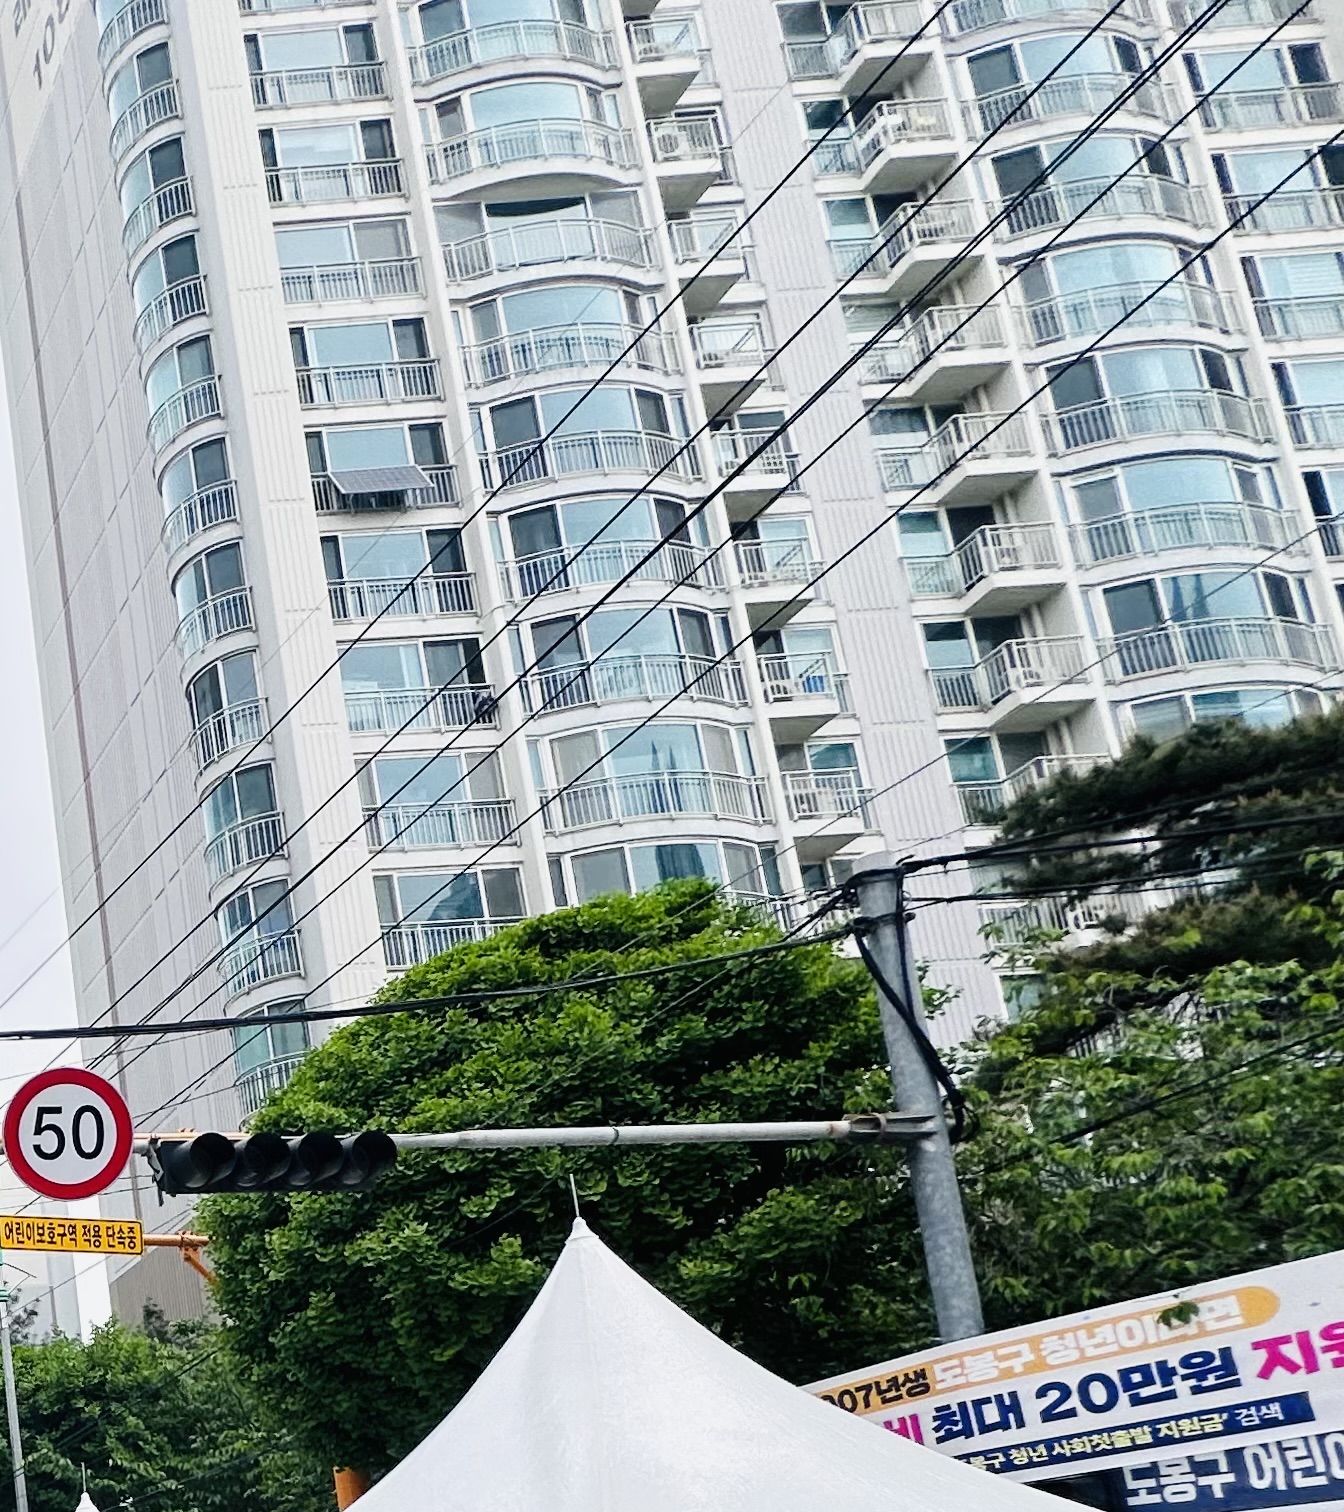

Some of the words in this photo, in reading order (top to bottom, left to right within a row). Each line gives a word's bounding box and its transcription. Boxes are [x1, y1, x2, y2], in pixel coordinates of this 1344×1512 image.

[31, 1104, 105, 1161] 50
[4, 1219, 78, 1247] 어린이보호구역
[81, 1223, 102, 1249] 적용
[105, 1225, 138, 1251] 단속중
[931, 1390, 1026, 1445] 최대
[1034, 1345, 1243, 1425] 20만원
[933, 1343, 1035, 1390] 도봉구
[962, 1453, 1007, 1472] 봉구
[1008, 1441, 1049, 1467] 청년
[1050, 1425, 1154, 1458] 사회첫출발
[1234, 1402, 1284, 1427] 검색
[1123, 1447, 1237, 1507] 도봉구
